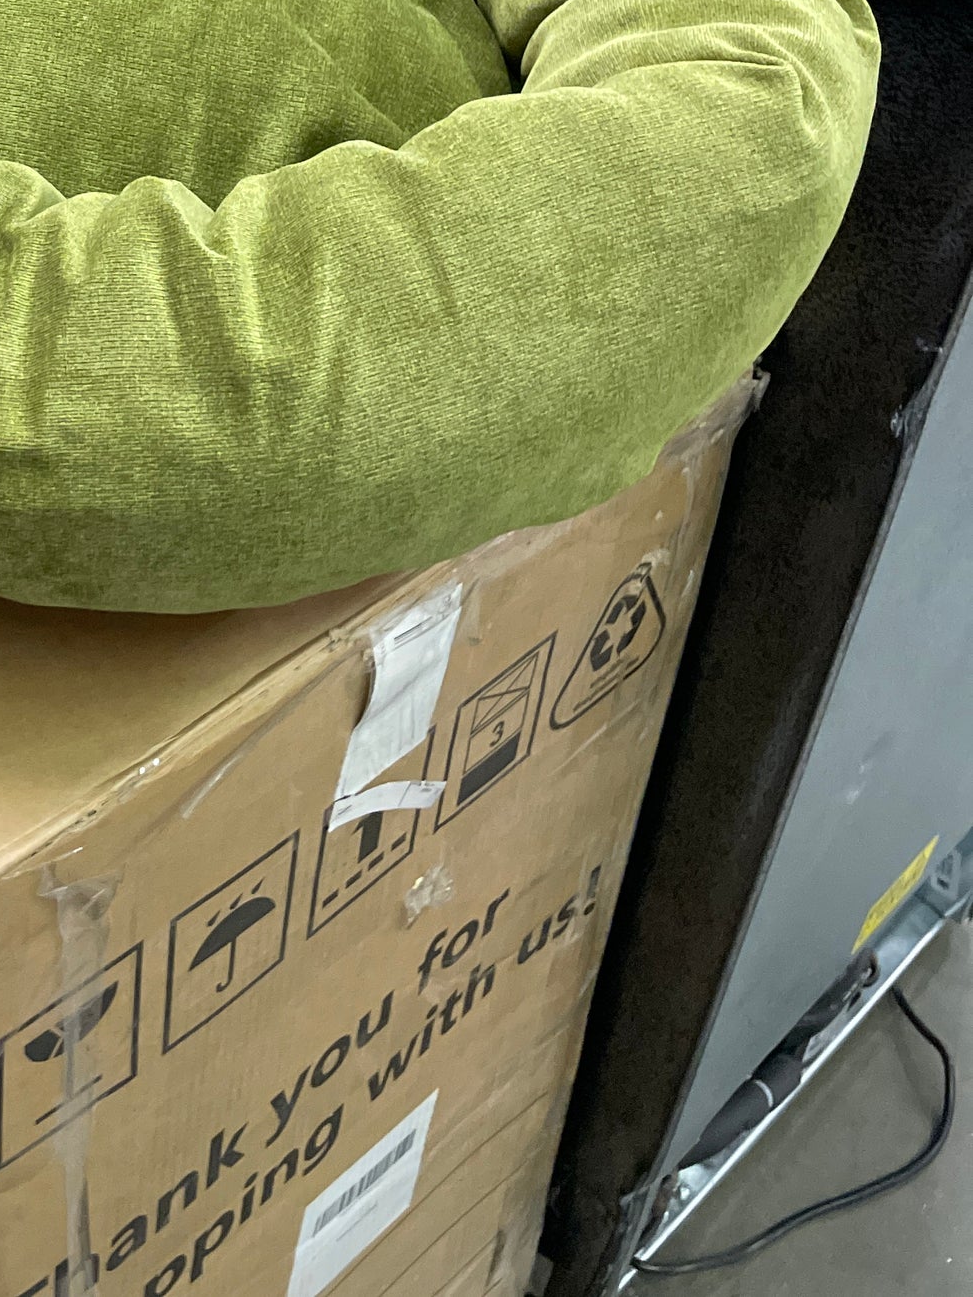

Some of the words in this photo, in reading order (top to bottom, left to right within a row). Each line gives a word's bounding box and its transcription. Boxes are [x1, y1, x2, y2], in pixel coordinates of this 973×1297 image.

[265, 988, 396, 1149] you
[417, 887, 511, 996] for
[366, 962, 497, 1103] with
[516, 864, 599, 966] us!
